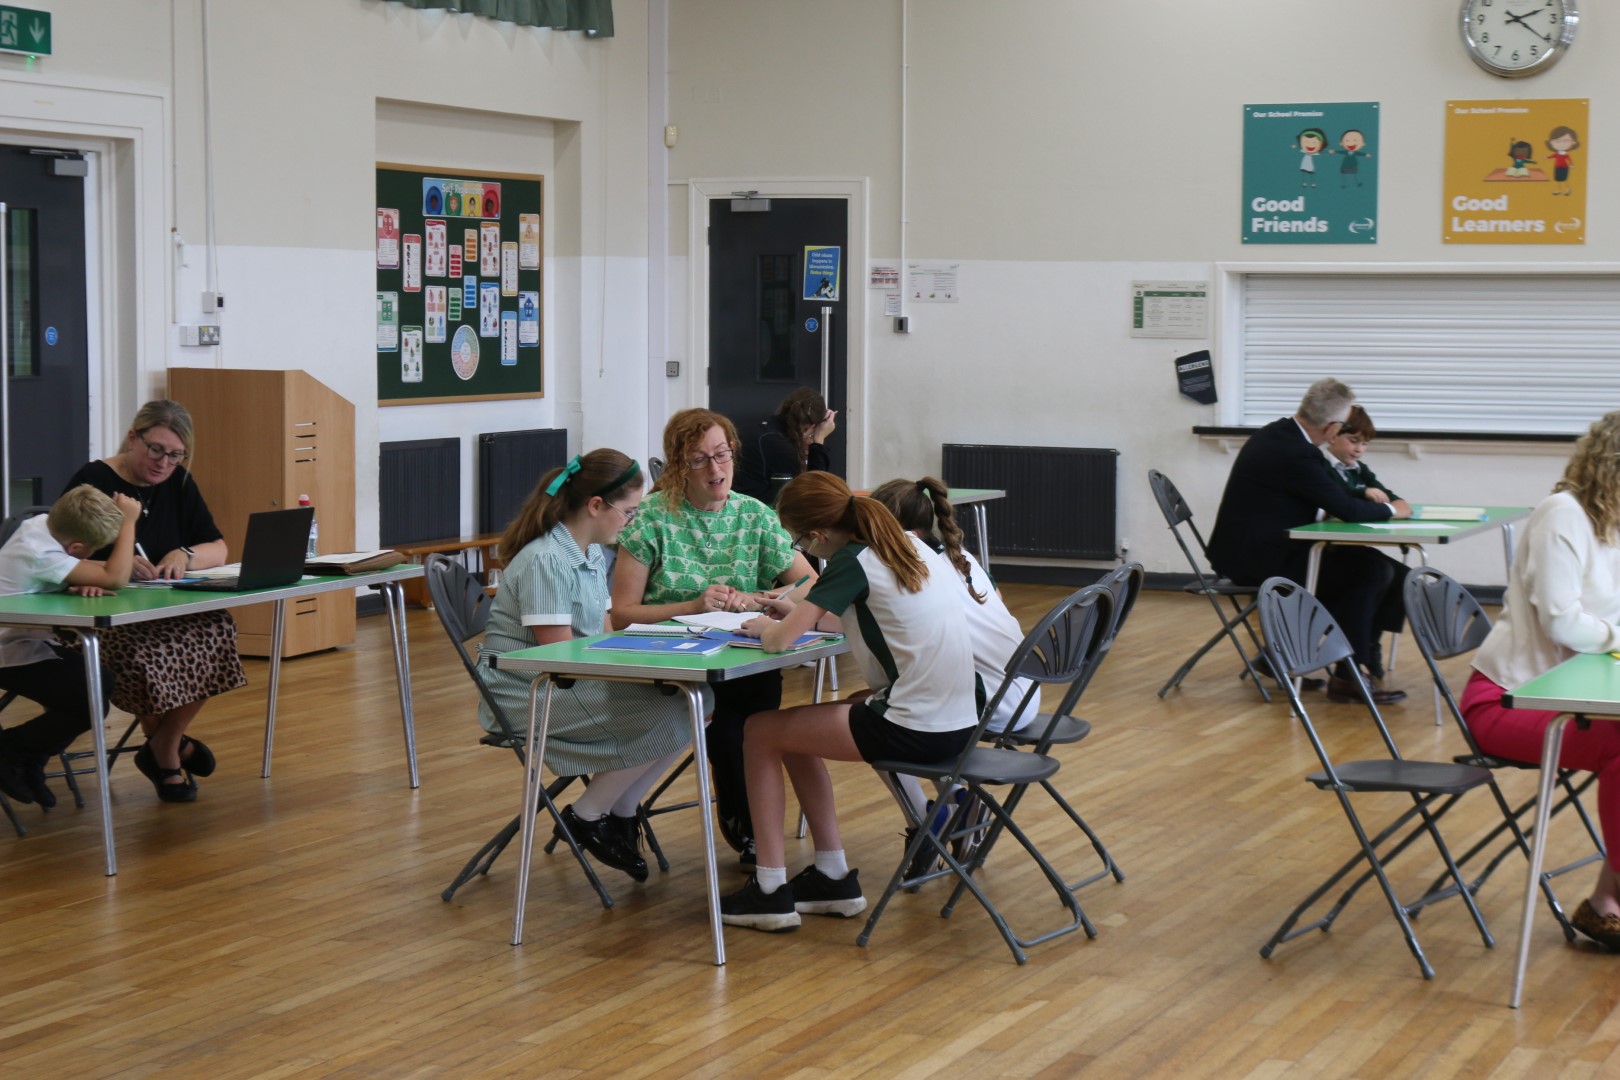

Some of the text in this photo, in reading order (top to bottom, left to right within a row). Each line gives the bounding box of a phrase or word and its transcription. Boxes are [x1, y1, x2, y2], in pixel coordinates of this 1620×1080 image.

[1477, 14, 1485, 25] 9
[1549, 13, 1557, 24] 3
[1481, 32, 1489, 43] 8
[1543, 32, 1552, 43] 4
[1494, 45, 1502, 56] 7
[1511, 50, 1519, 61] 6
[1530, 45, 1538, 56] 5
[1252, 196, 1304, 212] Good
[1452, 194, 1508, 211] Good
[1251, 215, 1329, 233] Friends
[1452, 216, 1546, 233] Learners
